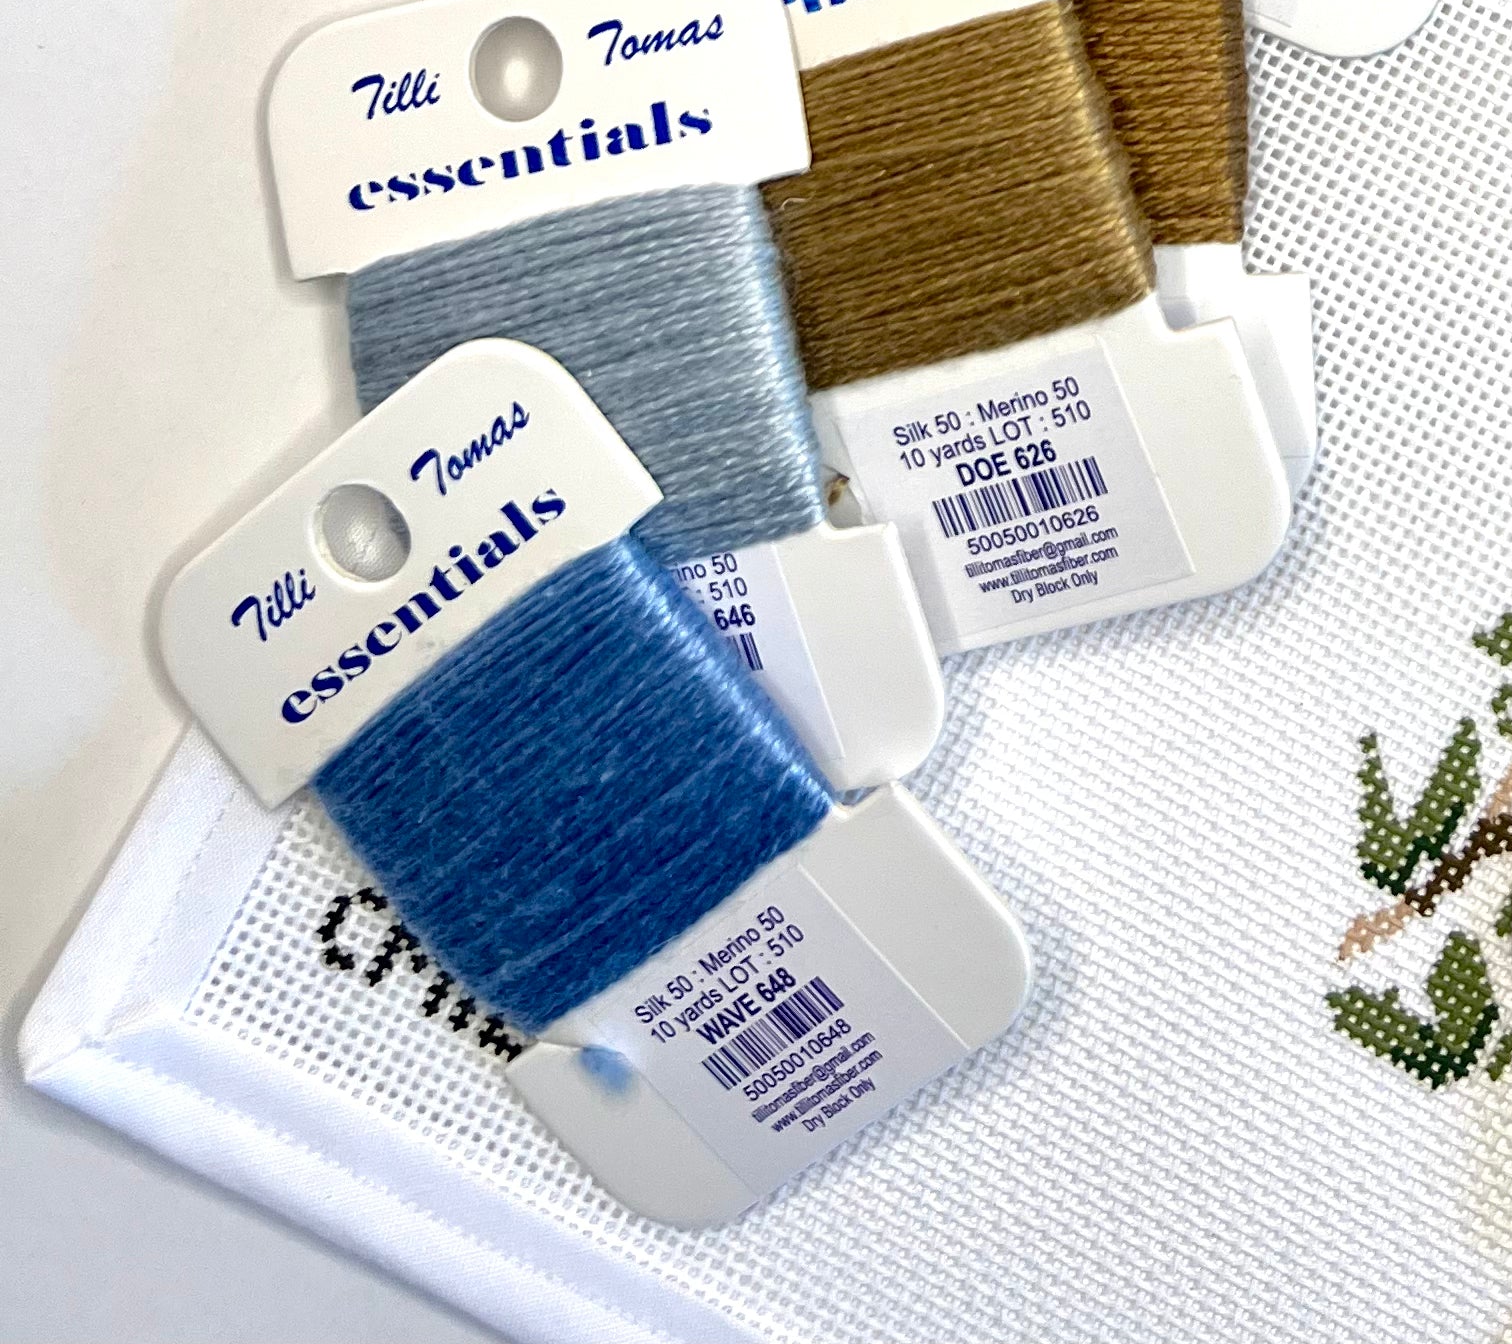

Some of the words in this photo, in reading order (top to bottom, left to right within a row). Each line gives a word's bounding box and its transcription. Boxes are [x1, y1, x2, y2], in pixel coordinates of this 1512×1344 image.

[351, 67, 441, 120] Tilli
[587, 13, 725, 67] Tomas
[347, 101, 714, 211] essentials
[893, 421, 934, 447] Silk
[934, 411, 962, 435] 50
[976, 390, 1049, 423] Merino
[1052, 376, 1080, 402] 50
[900, 448, 926, 471] 10
[928, 433, 987, 464] yards
[988, 415, 1033, 447] LOT
[1051, 400, 1092, 429] 510
[955, 452, 1013, 487] DOE
[1013, 440, 1058, 470] 626
[231, 568, 316, 642] Tilli
[410, 401, 530, 496] Tomas
[967, 505, 1100, 556] 50050010626
[709, 576, 749, 602] 510
[711, 552, 738, 576] 50
[1010, 588, 1034, 604] Dry
[1034, 577, 1072, 598] Block
[1070, 570, 1099, 588] Only
[281, 488, 566, 724] essentials
[713, 602, 757, 631] 646
[634, 994, 673, 1025] Silk
[665, 975, 695, 1001] 50
[697, 928, 762, 977] Merino
[756, 906, 785, 933] 50
[651, 1020, 677, 1044] 10
[673, 988, 724, 1028] yards
[716, 954, 760, 994] LOT
[765, 924, 805, 958] 510
[695, 992, 763, 1044] WAVE
[755, 967, 797, 1004] 648
[742, 1018, 852, 1103] 50050010648
